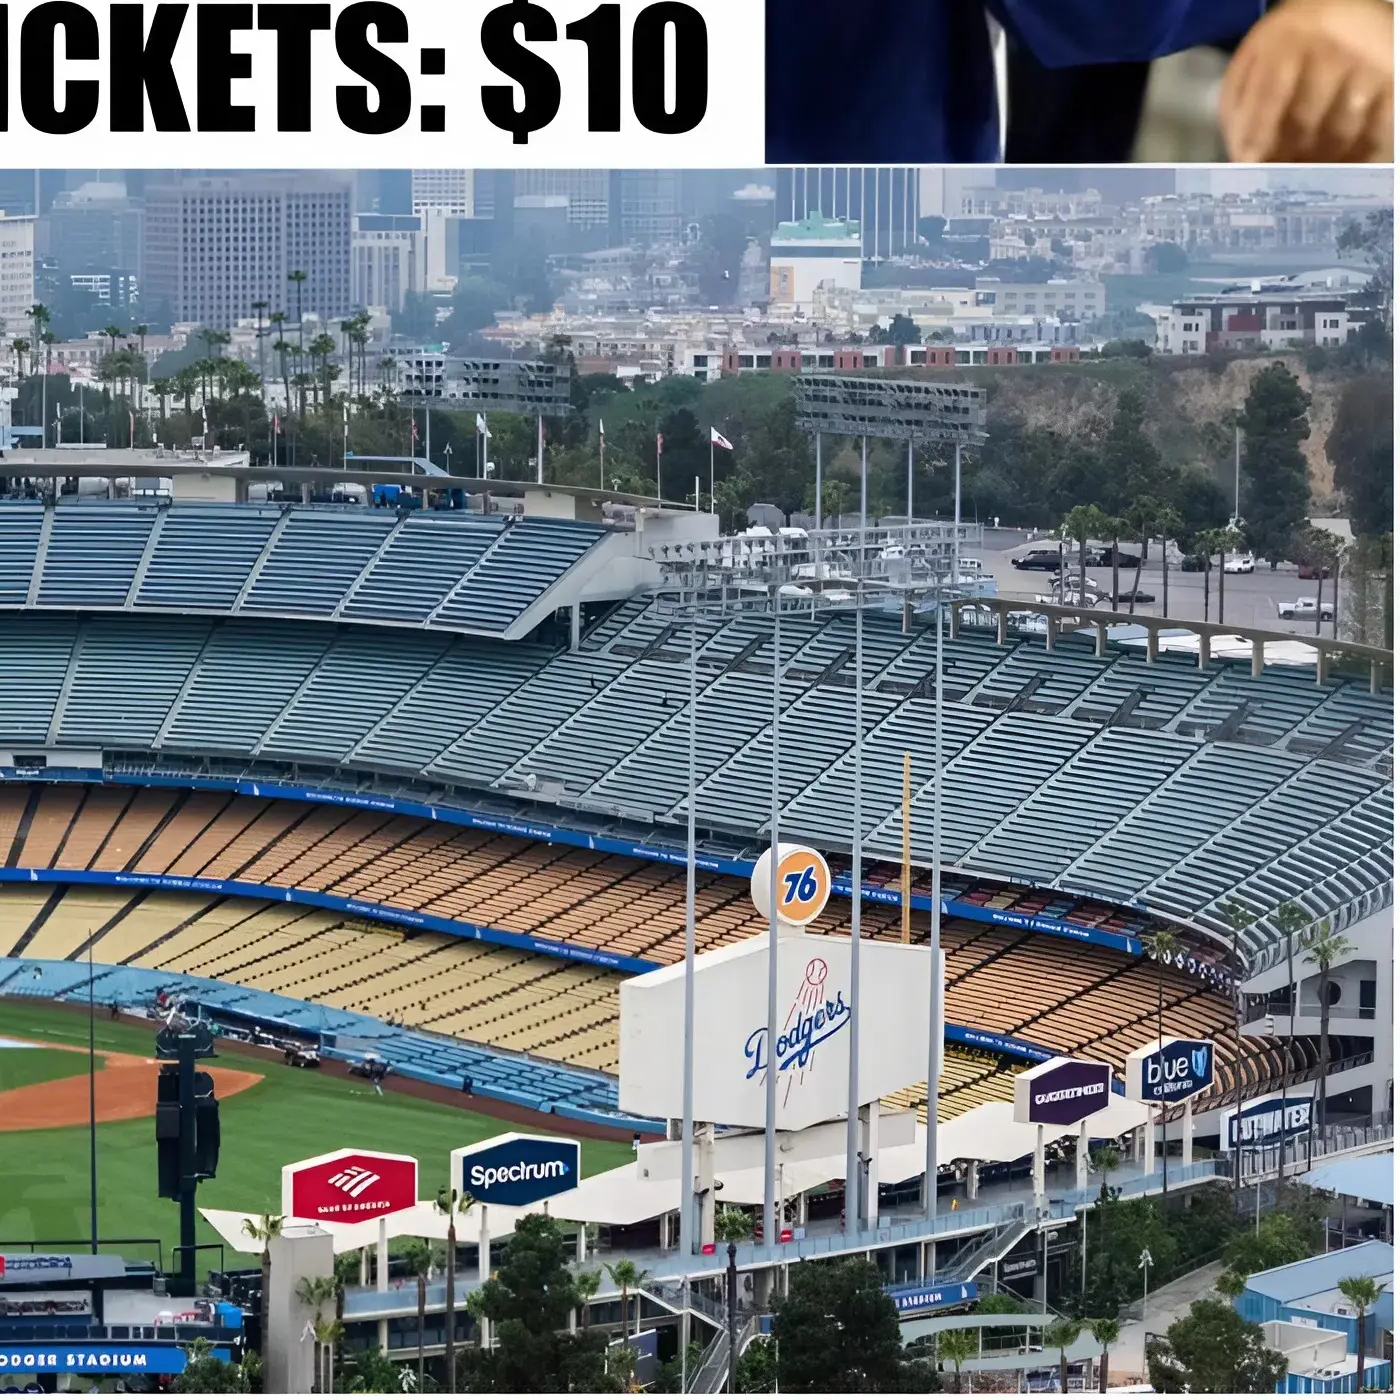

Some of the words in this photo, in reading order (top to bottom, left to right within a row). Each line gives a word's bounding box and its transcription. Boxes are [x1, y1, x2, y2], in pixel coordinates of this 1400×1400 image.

[783, 865, 817, 904] 76
[1147, 1056, 1189, 1084] bue
[470, 1160, 565, 1189] Spectrum
[66, 1354, 147, 1367] STADIUM
